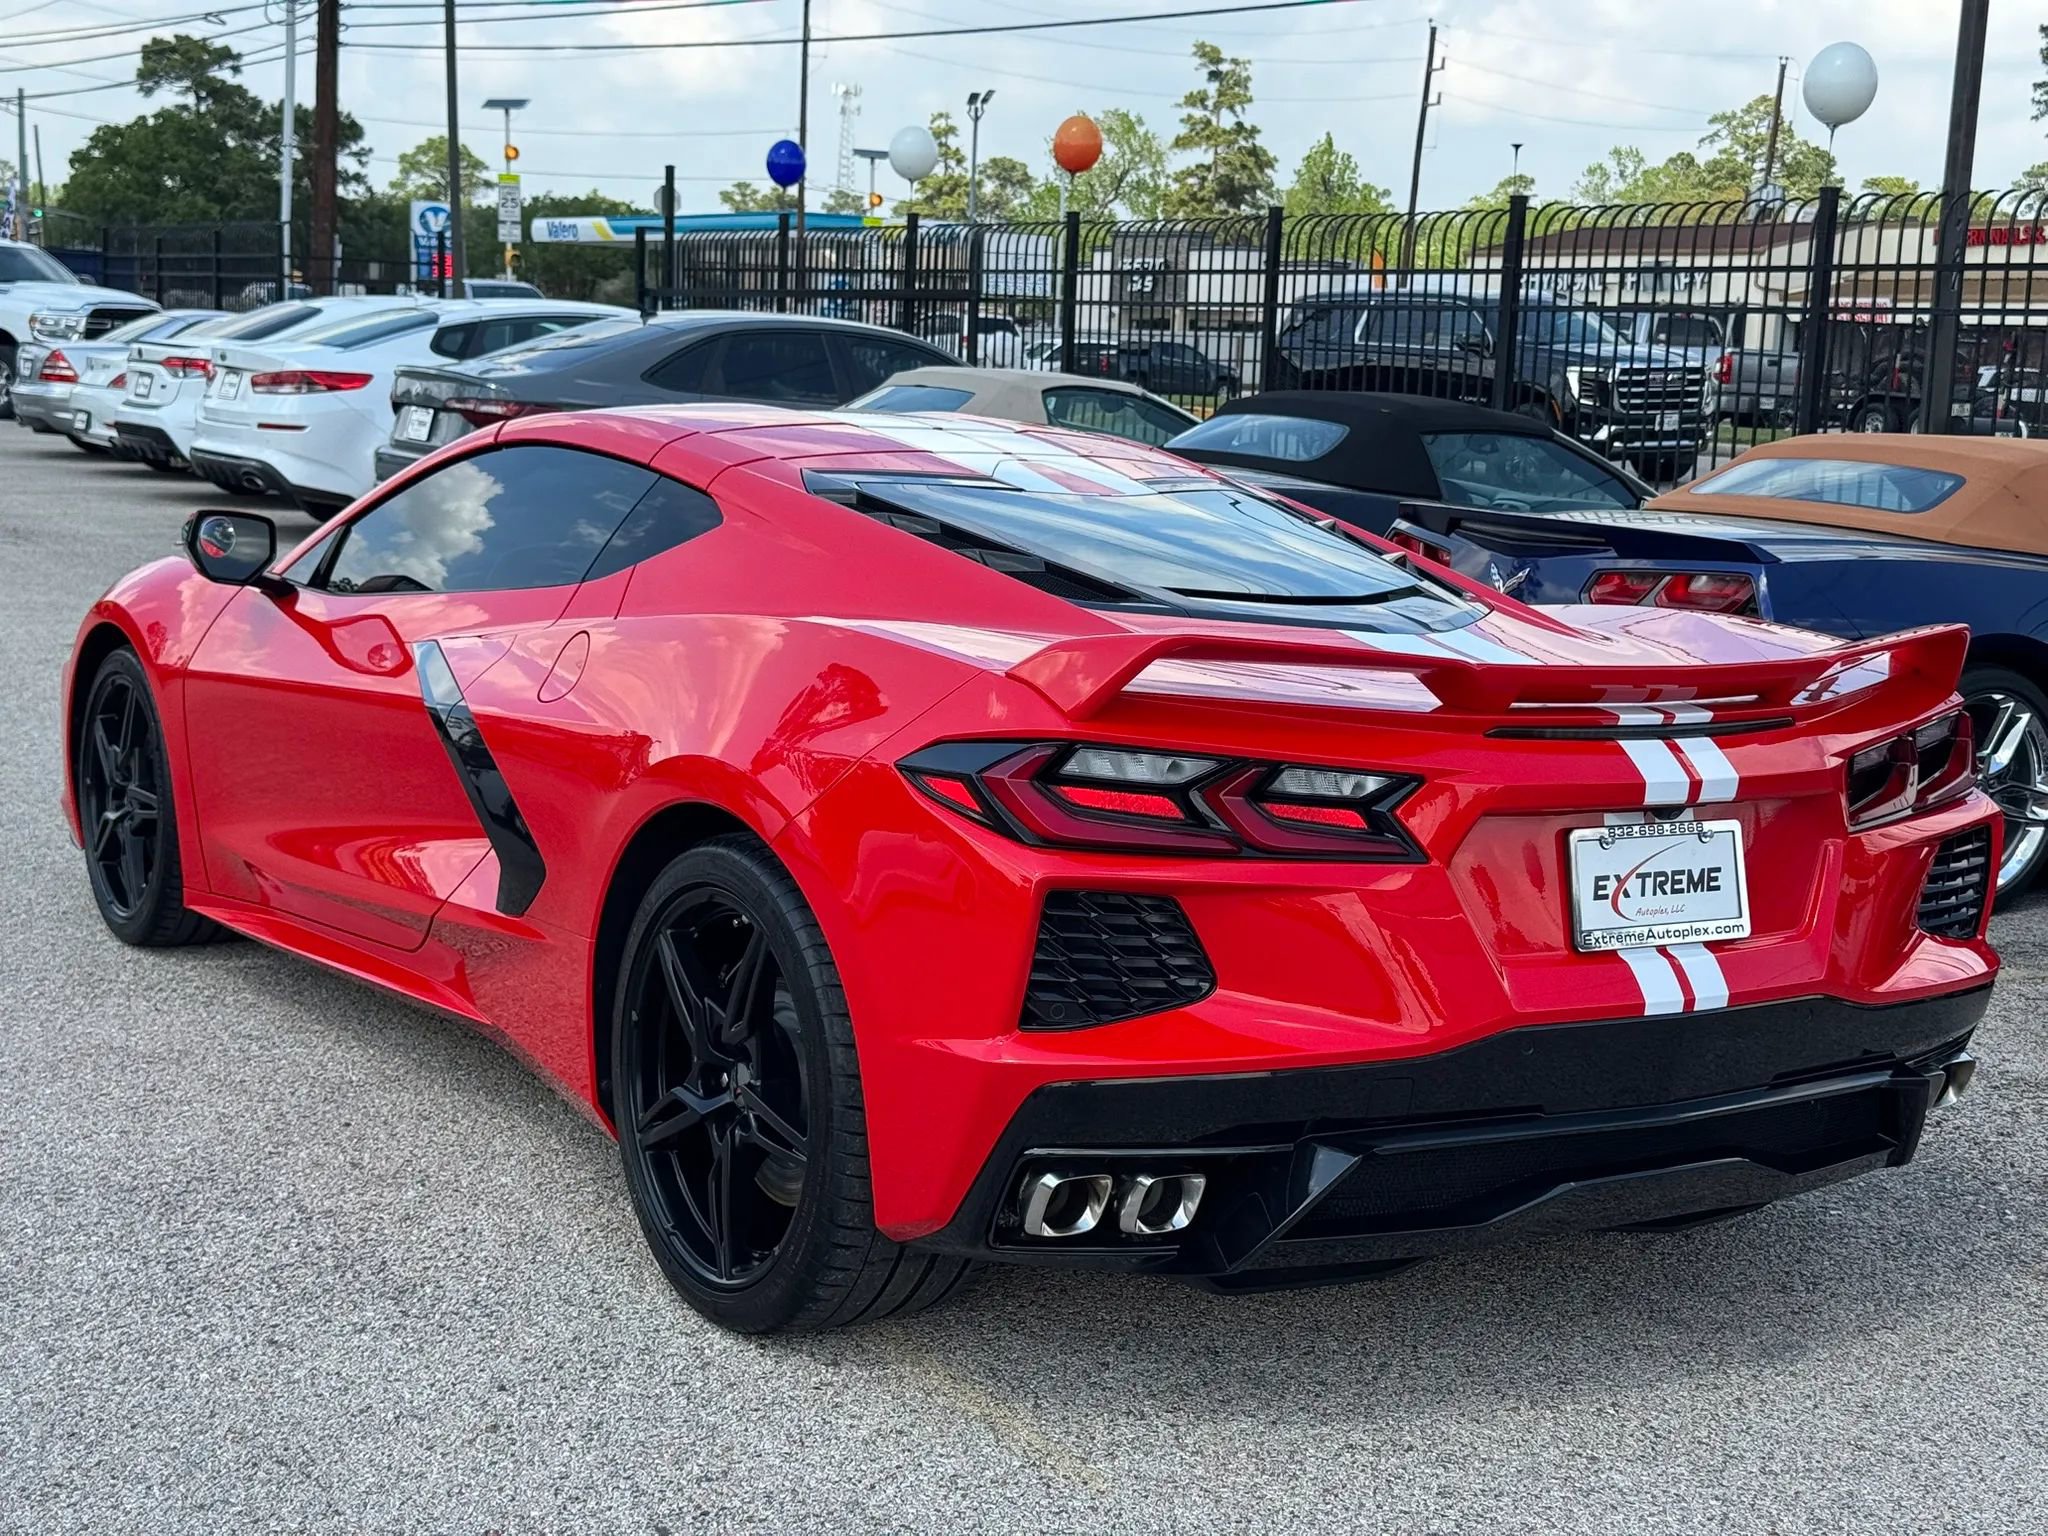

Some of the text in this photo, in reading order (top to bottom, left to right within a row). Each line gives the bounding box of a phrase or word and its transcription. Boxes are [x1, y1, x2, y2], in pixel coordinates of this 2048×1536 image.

[501, 197, 519, 209] 25
[546, 221, 579, 240] Valero
[1990, 224, 2032, 247] NALS
[1592, 866, 1722, 901] EXTREME
[1671, 904, 1686, 914] LLC
[1583, 923, 1745, 946] ExtremeAutoplex.com
